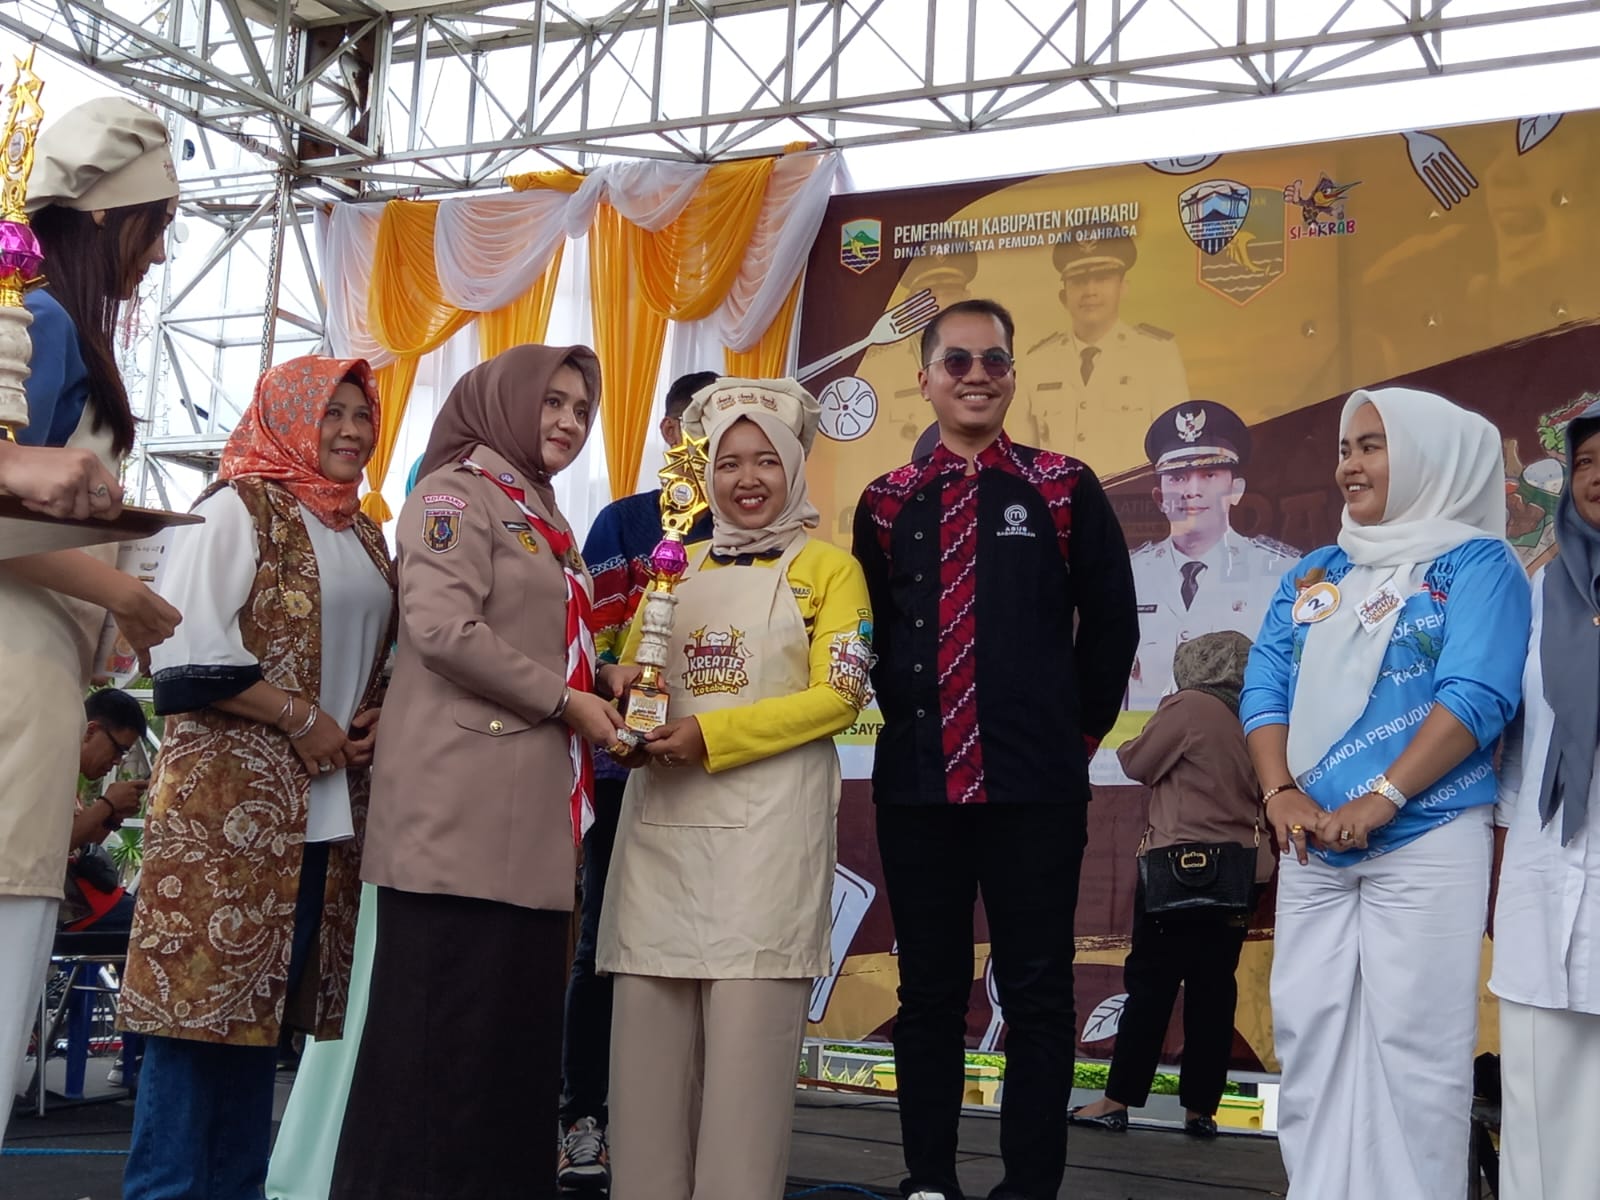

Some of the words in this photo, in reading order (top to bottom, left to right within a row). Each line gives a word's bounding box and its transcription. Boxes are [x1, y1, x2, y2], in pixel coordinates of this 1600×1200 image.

[894, 218, 978, 244] PEMERINTAH
[982, 208, 1061, 236] KABUPATEN
[1065, 202, 1139, 227] KOTABARU
[1289, 219, 1356, 240] SI-AKRAB
[893, 244, 927, 260] DINAS
[929, 238, 995, 257] PARIWISATA
[998, 234, 1045, 249] PEMUDA
[1047, 230, 1072, 245] DAN
[1075, 224, 1138, 243] OLAHRAGA
[1308, 598, 1325, 611] 2
[690, 655, 743, 671] KREATIF
[684, 668, 747, 689] KULINER
[1323, 738, 1367, 772] TANDA
[1418, 784, 1457, 809] KAOS
[1455, 762, 1492, 791] TANDA
